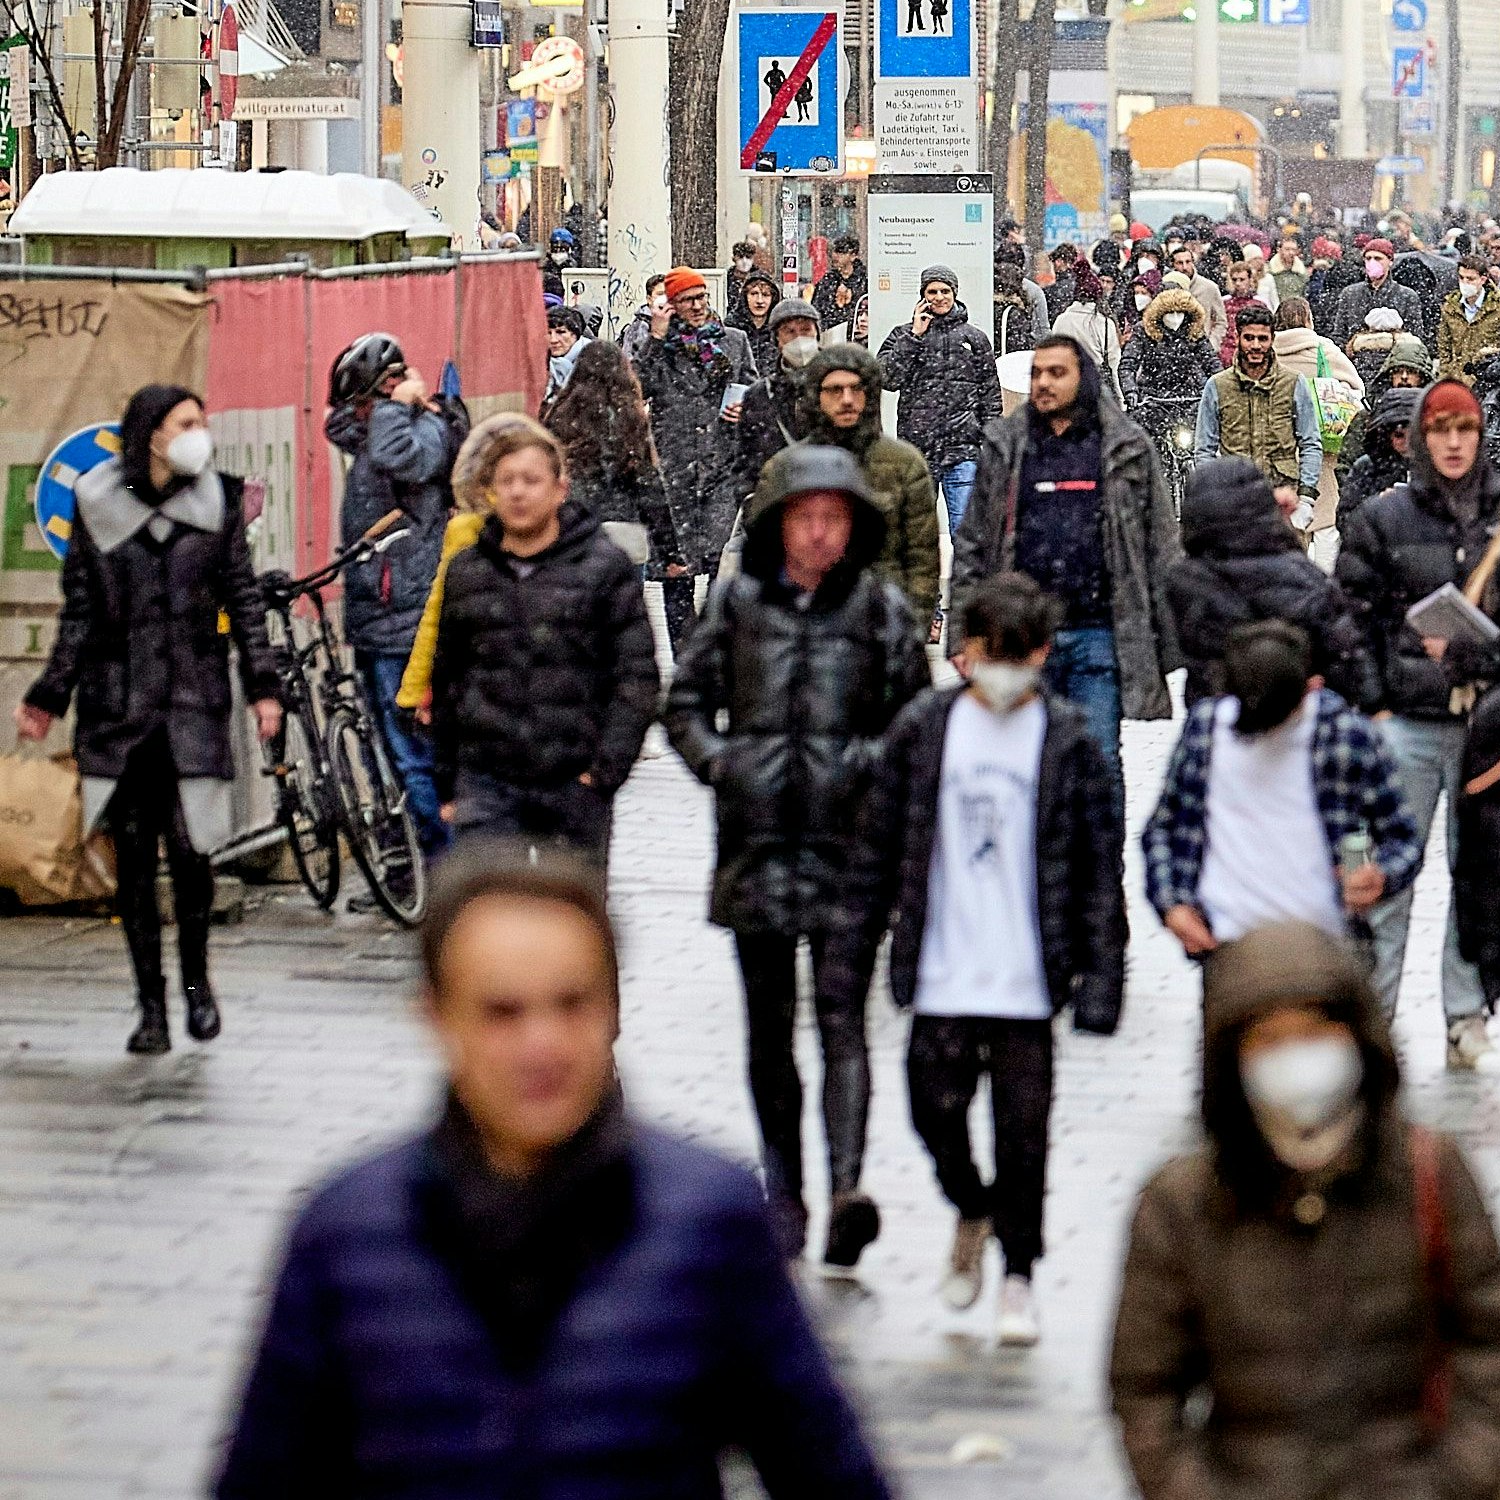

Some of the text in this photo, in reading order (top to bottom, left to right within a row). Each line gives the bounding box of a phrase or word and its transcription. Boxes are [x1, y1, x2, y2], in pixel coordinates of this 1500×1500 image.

[894, 88, 956, 98] ausgenommen
[895, 113, 908, 121] die
[910, 113, 940, 121] Zufahrt
[882, 124, 938, 135] Ladetätigkeit,
[943, 124, 959, 133] Taxi
[880, 137, 971, 146] Behindertentransporte
[901, 148, 918, 157] Aus-
[927, 147, 969, 158] Einsteigen
[914, 160, 937, 169] sowie
[878, 215, 935, 225] Neubaugasse
